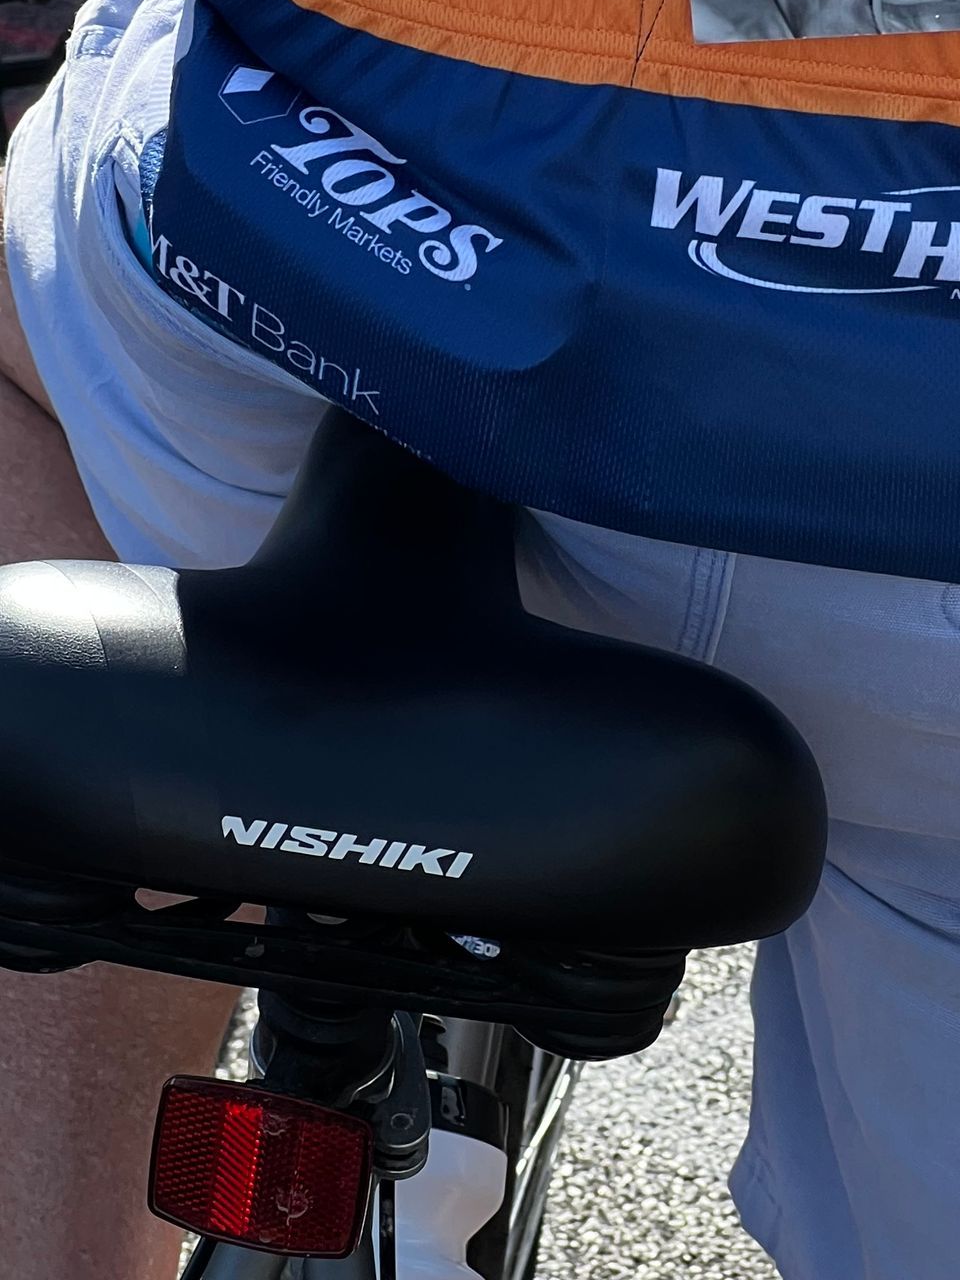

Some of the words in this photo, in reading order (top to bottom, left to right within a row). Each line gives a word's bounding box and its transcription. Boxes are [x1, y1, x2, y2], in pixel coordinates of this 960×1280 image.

[250, 150, 329, 217] Friendly
[328, 206, 413, 275] Markets
[250, 303, 381, 416] Bank
[221, 815, 474, 879] NISHIKI
